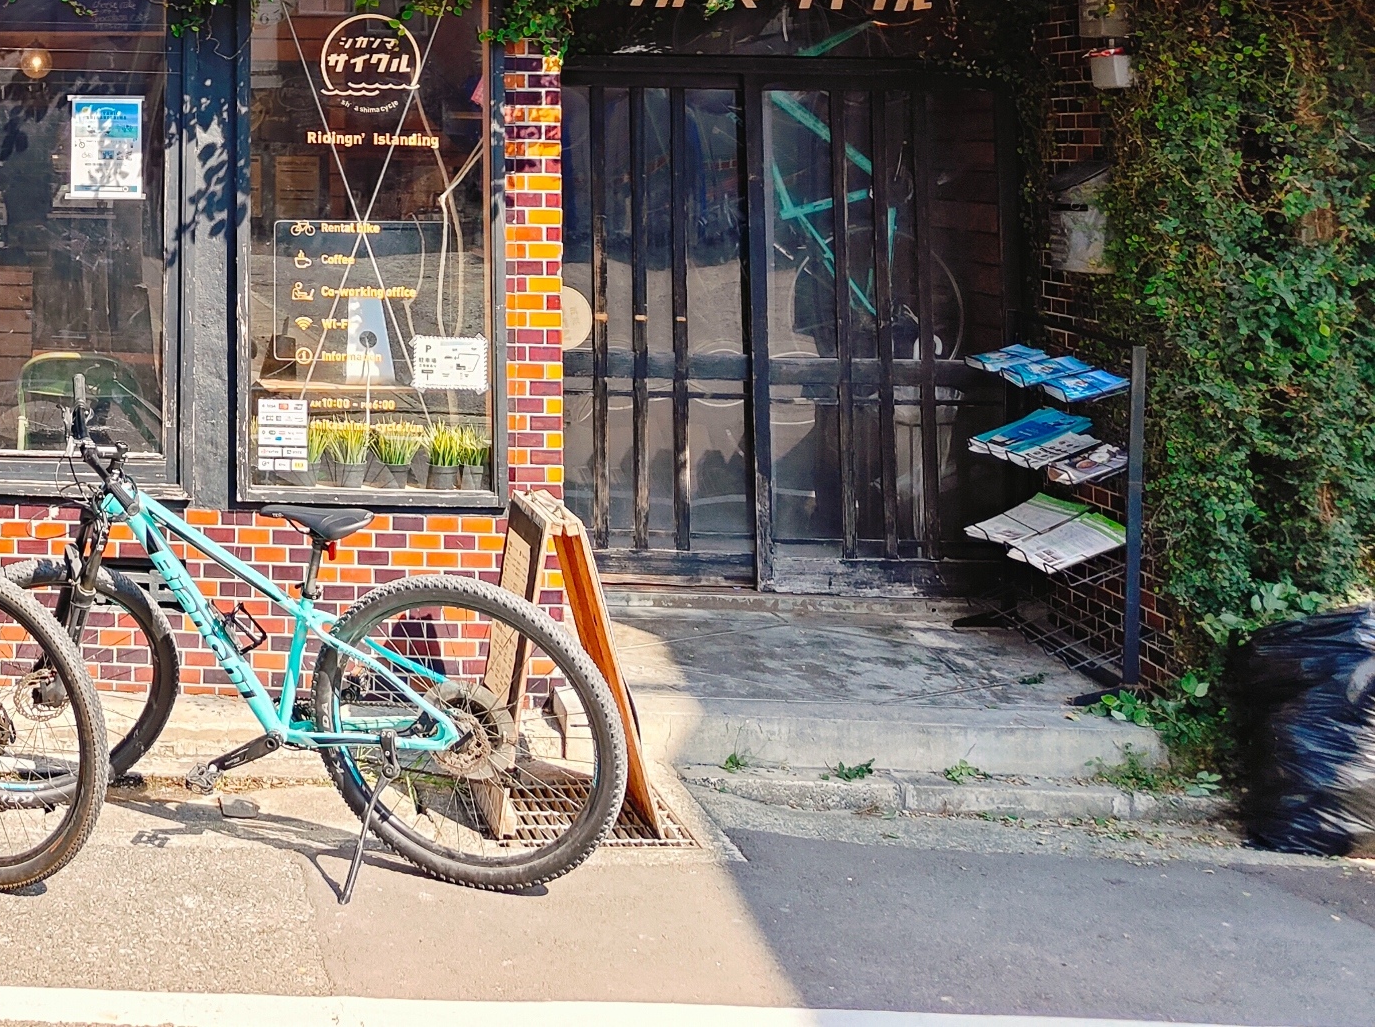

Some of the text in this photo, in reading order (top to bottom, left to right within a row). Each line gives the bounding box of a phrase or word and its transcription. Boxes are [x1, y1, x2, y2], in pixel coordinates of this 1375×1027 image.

[327, 53, 411, 73] サイクル
[373, 132, 440, 149] Islanding
[321, 222, 381, 234] Rental bike
[321, 254, 355, 265] Coffee
[321, 285, 417, 300] Co-working office
[321, 318, 352, 330] Wi-F
[322, 350, 382, 363] Informaon
[150, 551, 257, 698] Bianchi
